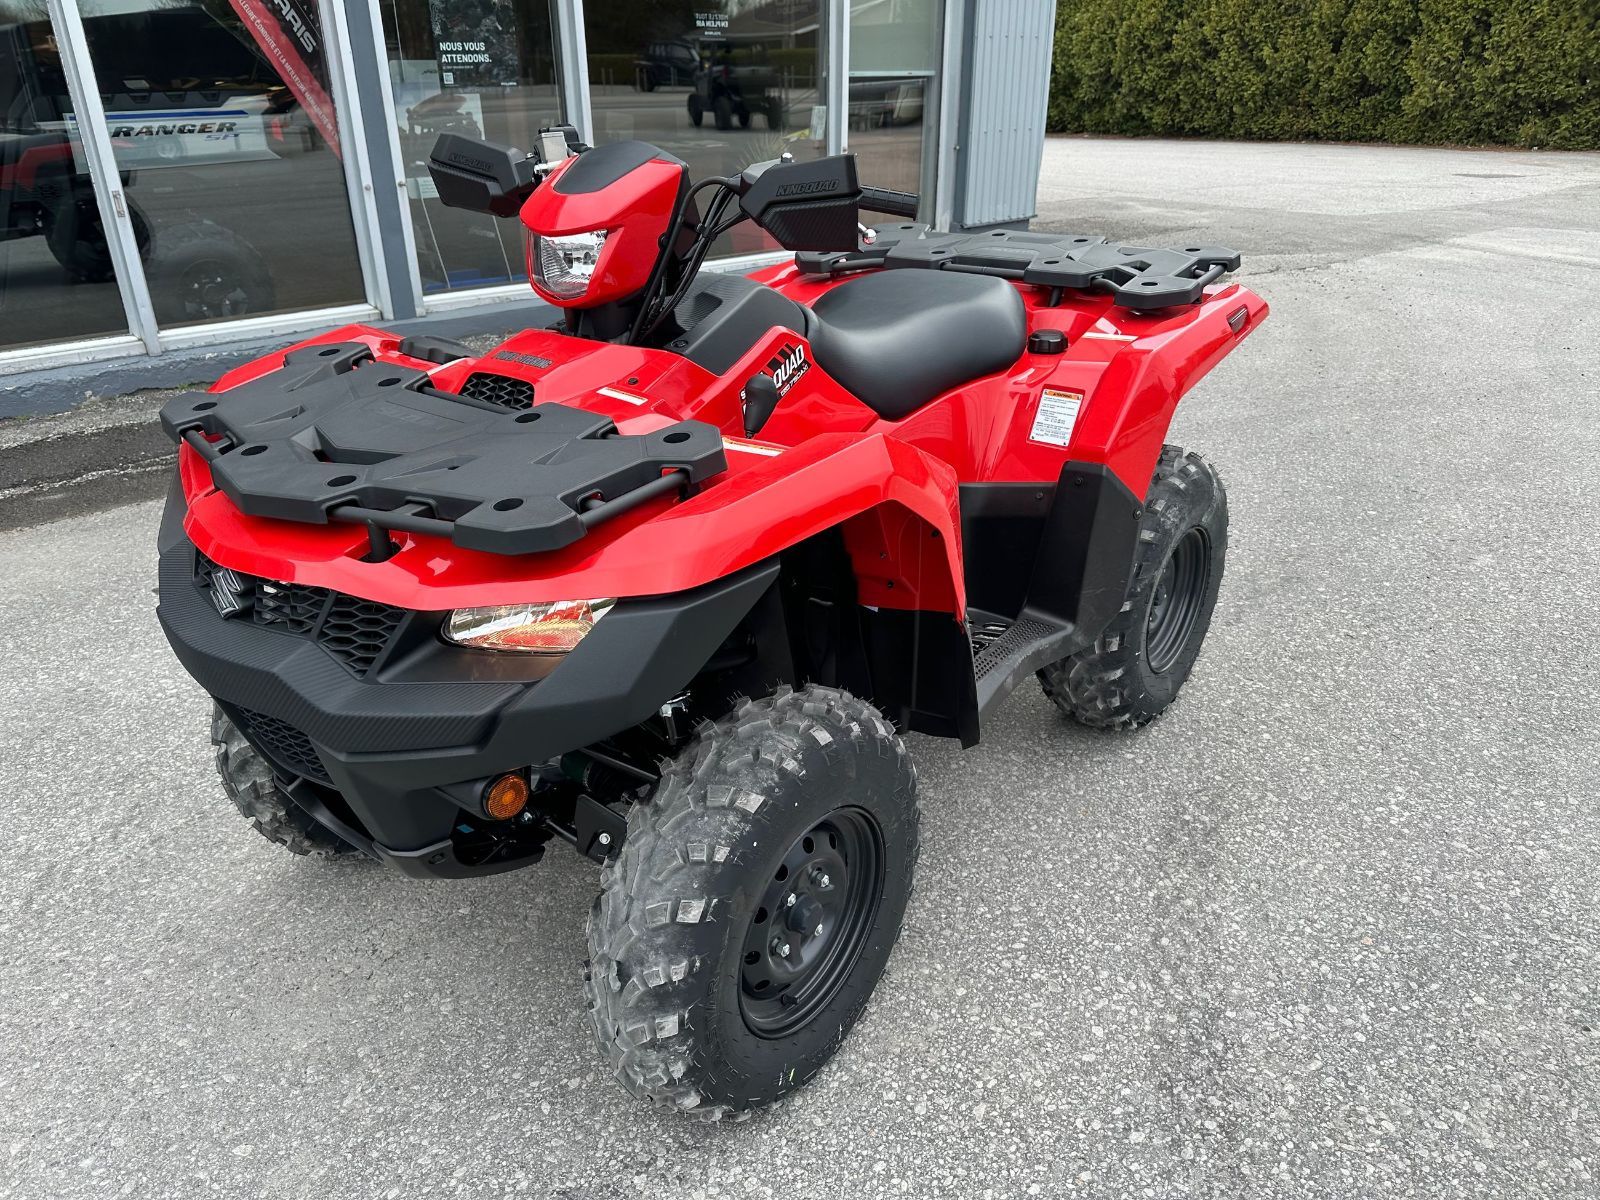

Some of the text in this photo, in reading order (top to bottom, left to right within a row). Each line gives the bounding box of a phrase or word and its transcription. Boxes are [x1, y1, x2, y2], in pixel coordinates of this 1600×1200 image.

[254, 18, 277, 50] CONDUITE
[273, 47, 282, 57] ET
[279, 55, 287, 65] LA
[440, 42, 485, 51] NOUS VOUS
[442, 53, 492, 63] ATTENDONS.
[112, 121, 237, 138] RANGER
[776, 179, 840, 197] KINGQUAD
